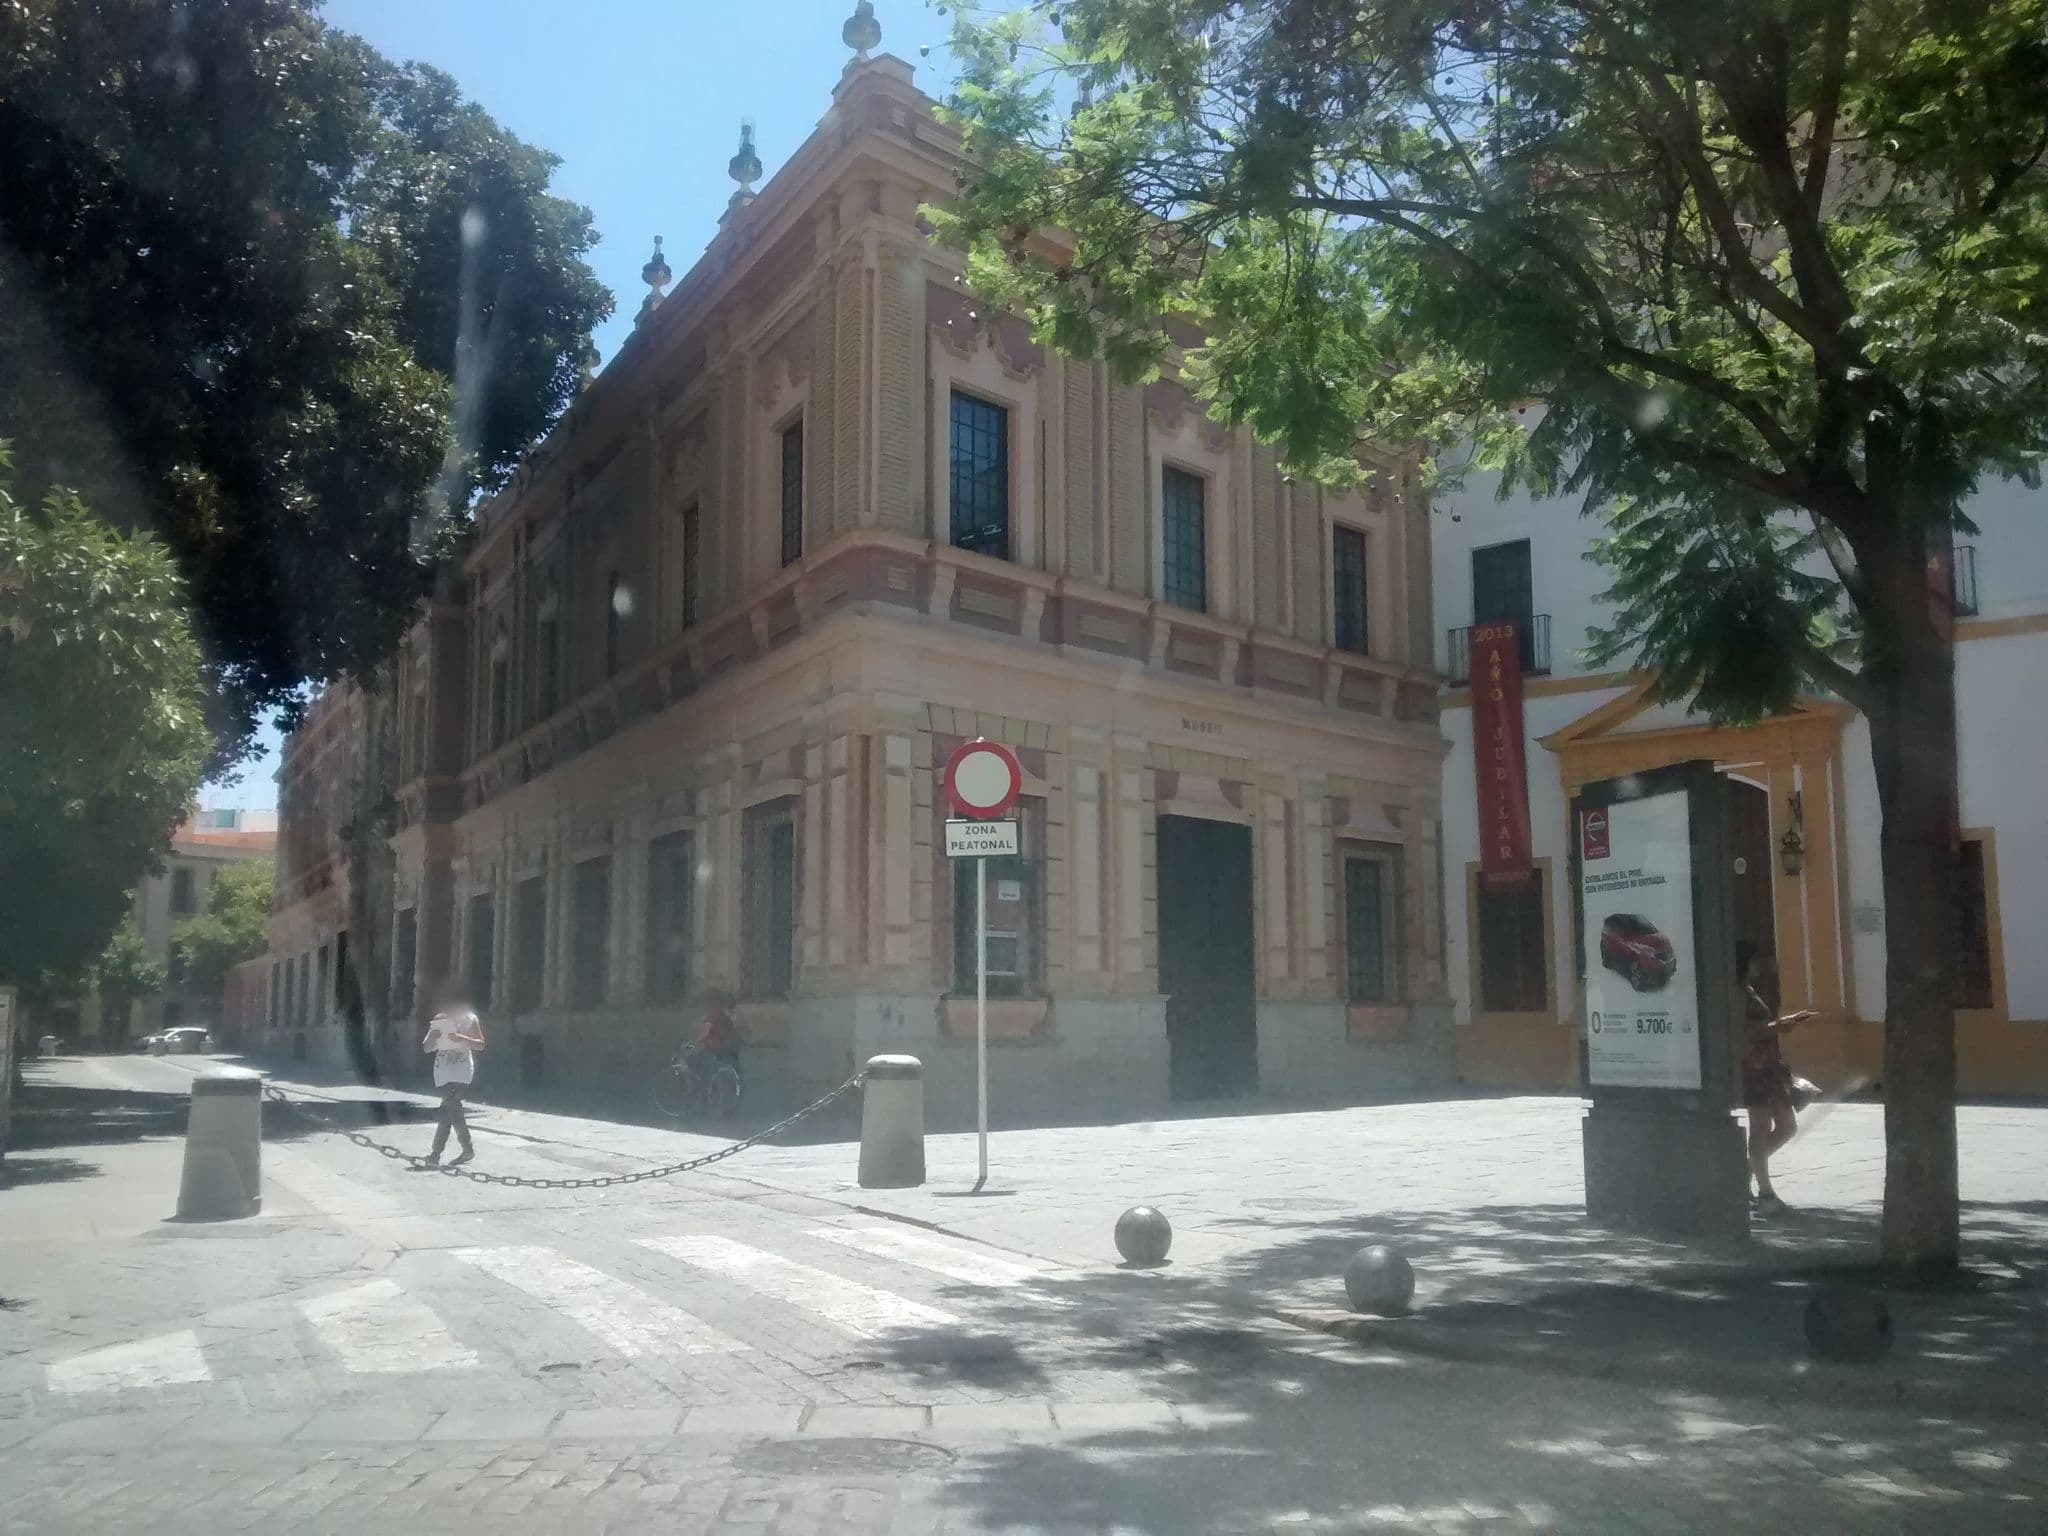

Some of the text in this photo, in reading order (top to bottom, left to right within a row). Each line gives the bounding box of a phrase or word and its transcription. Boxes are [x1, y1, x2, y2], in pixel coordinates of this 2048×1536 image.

[1475, 625, 1513, 642] 2013
[1489, 649, 1513, 859] AÑO JUBILAR
[965, 825, 997, 835] ZONA
[951, 840, 1013, 850] PEATONAL
[1585, 871, 1619, 883] DOBLAMOS
[1620, 870, 1628, 879] EL
[1630, 879, 1637, 888] NI
[1592, 1011, 1601, 1034] 0
[1637, 1018, 1672, 1034] 9.700€
